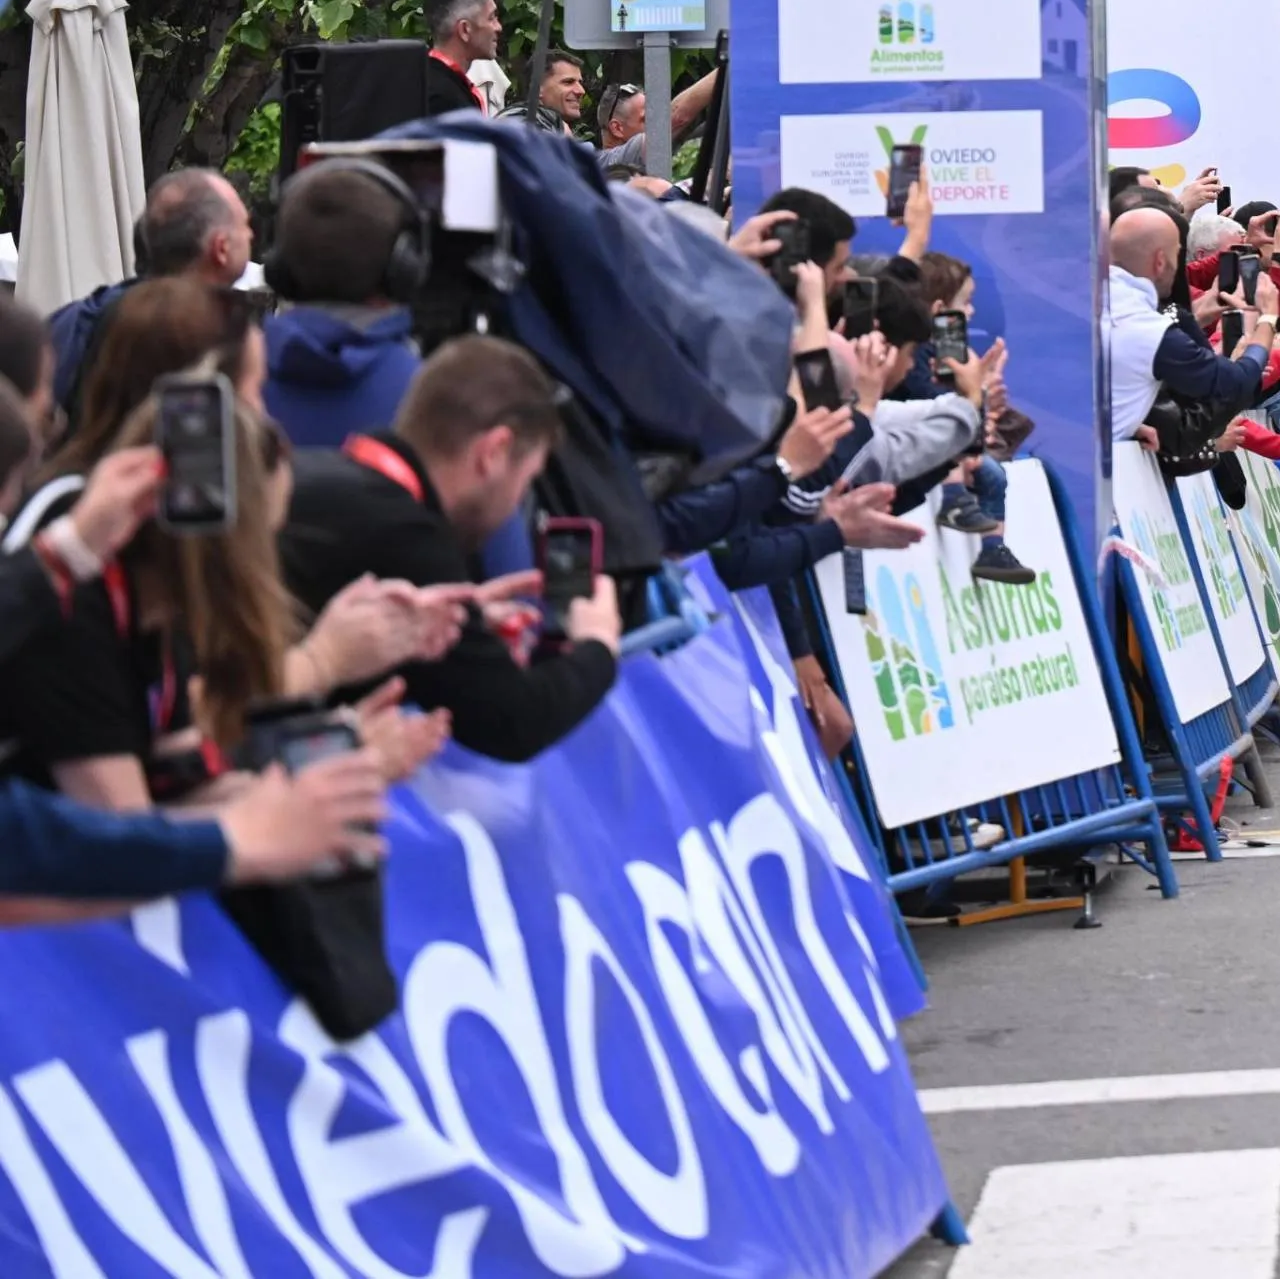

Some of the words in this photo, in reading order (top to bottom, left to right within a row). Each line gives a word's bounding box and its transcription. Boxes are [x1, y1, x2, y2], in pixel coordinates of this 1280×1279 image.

[870, 48, 943, 63] Alimentos
[930, 148, 996, 164] OVIEDO
[931, 167, 968, 183] VIVE
[975, 167, 994, 182] EL
[932, 185, 1009, 201] DEPORTE
[960, 651, 1022, 724] paraíso
[1021, 642, 1080, 701] natural
